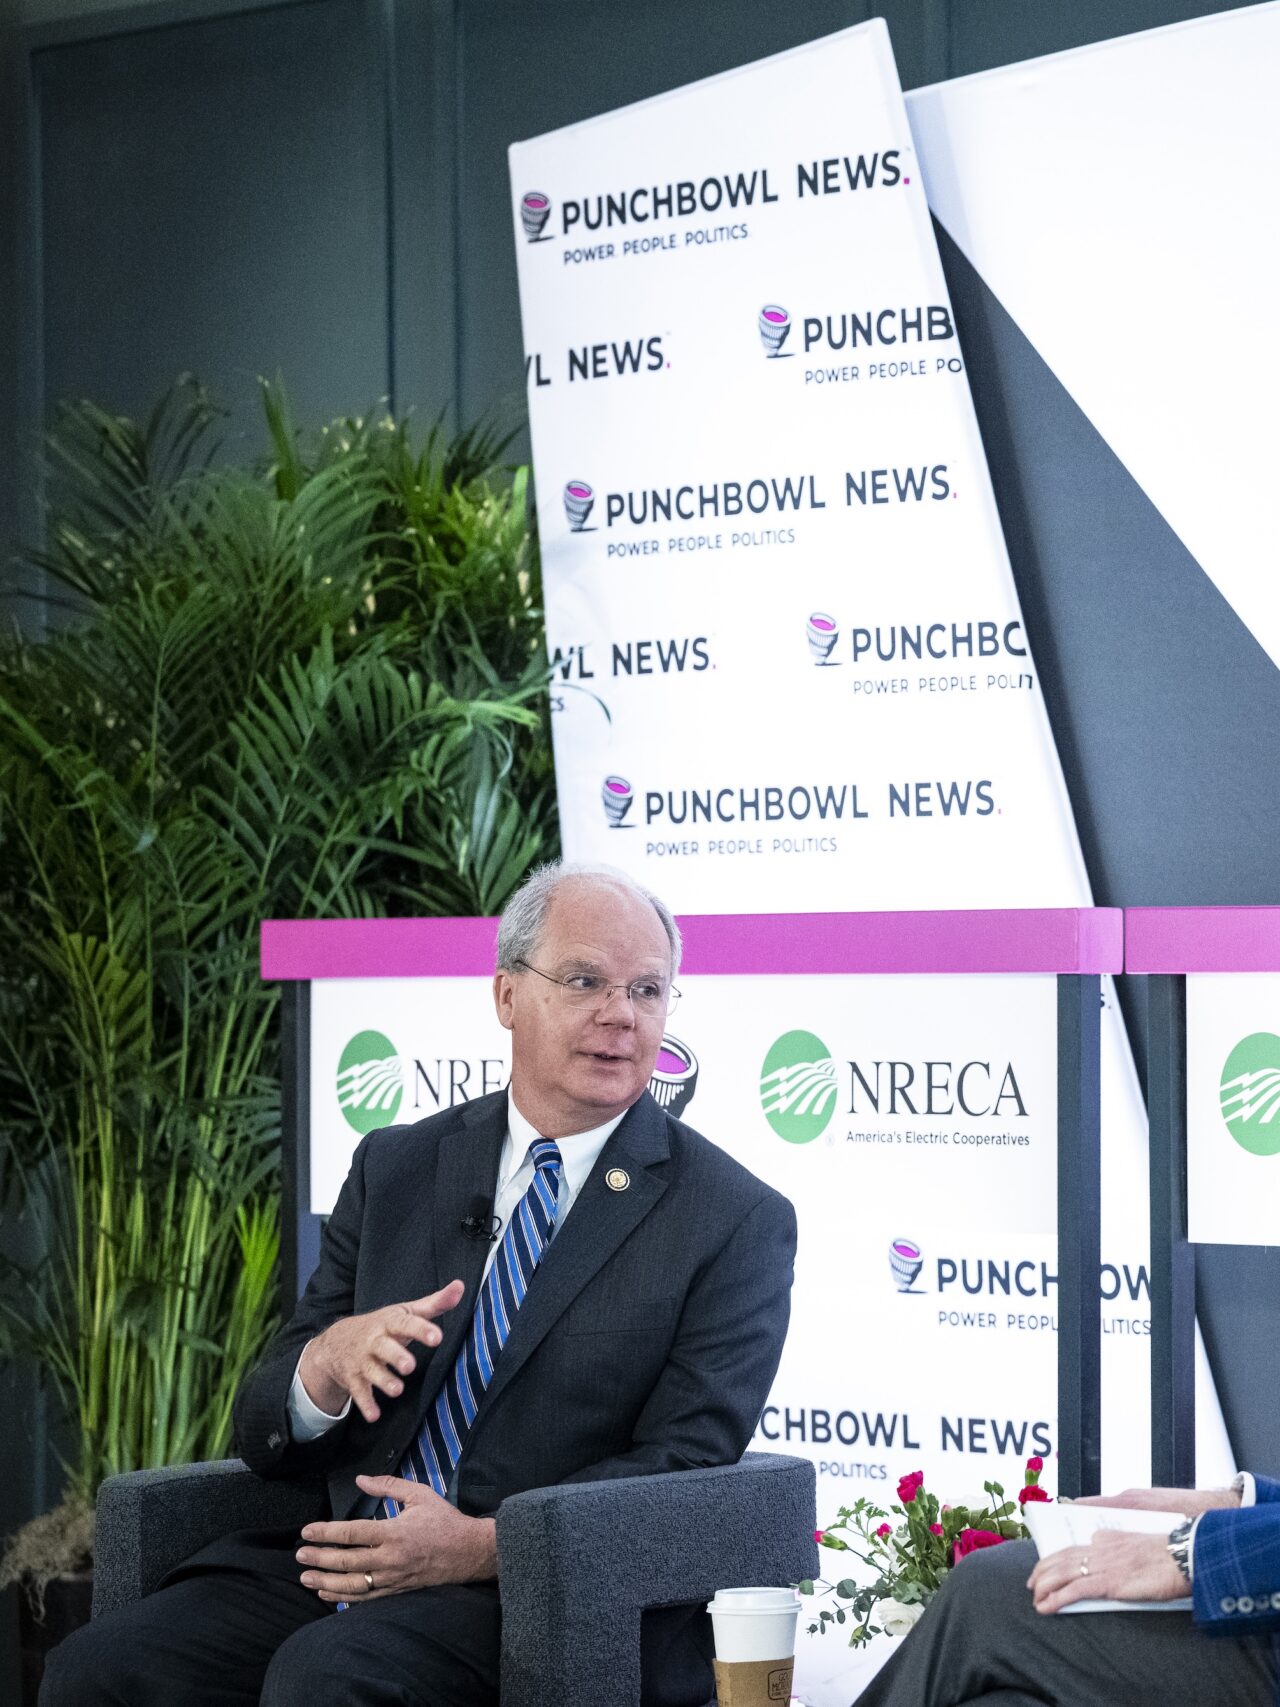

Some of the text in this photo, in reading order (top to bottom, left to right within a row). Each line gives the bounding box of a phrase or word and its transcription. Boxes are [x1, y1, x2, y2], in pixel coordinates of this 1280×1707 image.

[562, 150, 910, 234] PUNCHBOWL NEWS.
[564, 223, 749, 265] POWER PEOPLE POLITICS
[804, 305, 954, 353] PUNCHB
[568, 336, 671, 382] NEWS.
[805, 366, 860, 385] POWER
[869, 360, 927, 379] PEOPLE
[607, 464, 958, 527] PUNCHBOWL NEWS.
[607, 528, 796, 558] POWER PEOPLE POLITICS
[612, 637, 717, 677] NEWS.
[853, 677, 909, 695] POWER
[919, 674, 977, 692] PEOPLE
[646, 780, 1003, 825] PUNCHBOWL NEWS.
[646, 837, 838, 857] POWER PEOPLE POLITICS
[846, 1061, 1030, 1117] NRECA
[846, 1130, 1030, 1147] America's Electric Cooperatives
[938, 1310, 997, 1329] POWER
[753, 1405, 920, 1450] CHBOWL
[820, 1461, 888, 1481] POLITICS
